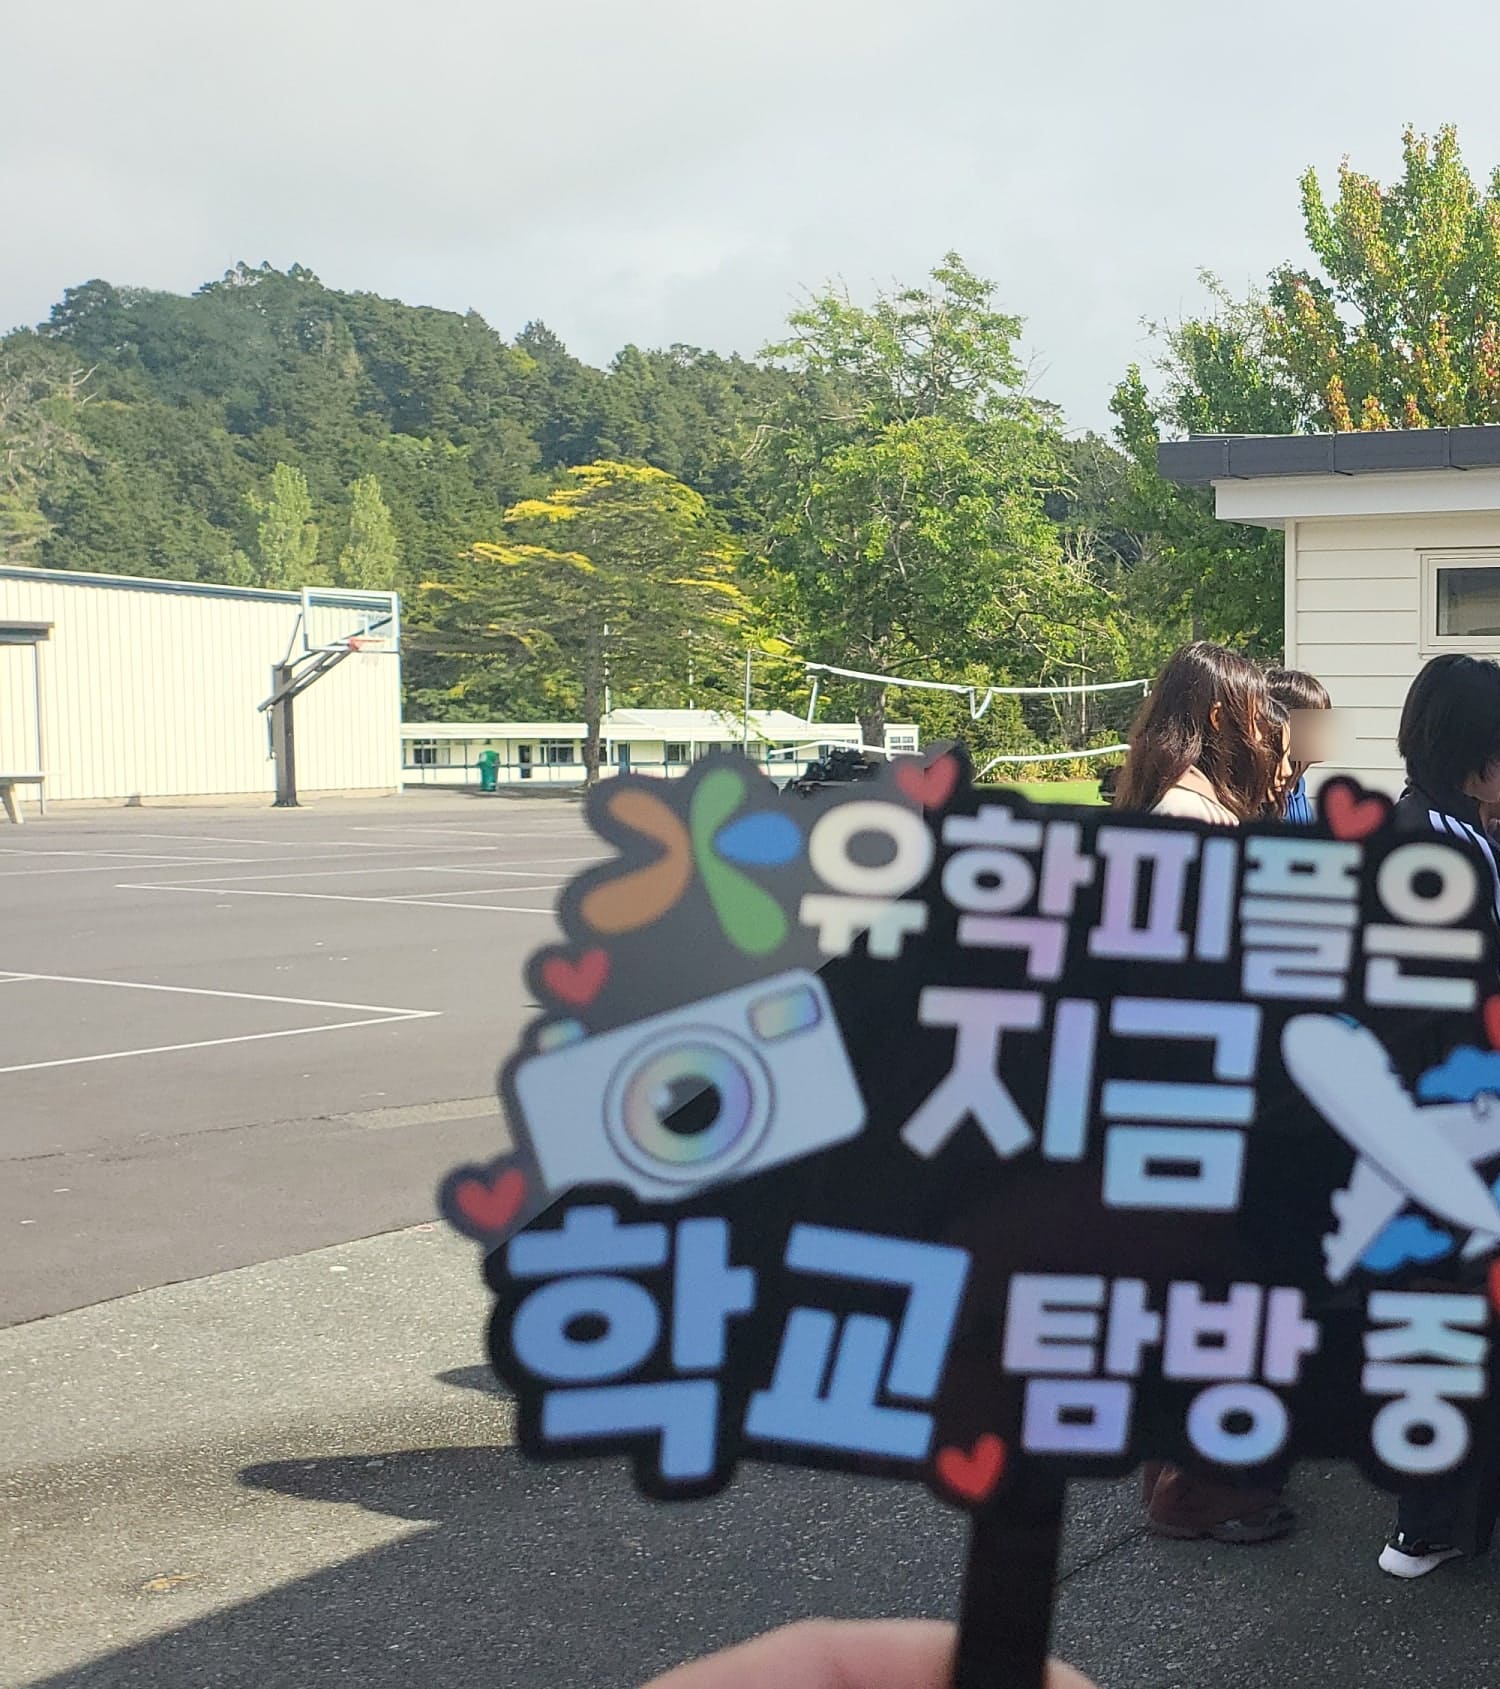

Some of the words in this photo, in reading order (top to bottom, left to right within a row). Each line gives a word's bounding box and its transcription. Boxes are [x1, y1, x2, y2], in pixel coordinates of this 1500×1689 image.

[800, 801, 1487, 1010] 유학피플은
[901, 987, 1260, 1212] 지금
[509, 1205, 971, 1482] 학교
[1003, 1272, 1318, 1468] 탐방
[1364, 1289, 1492, 1476] 중
